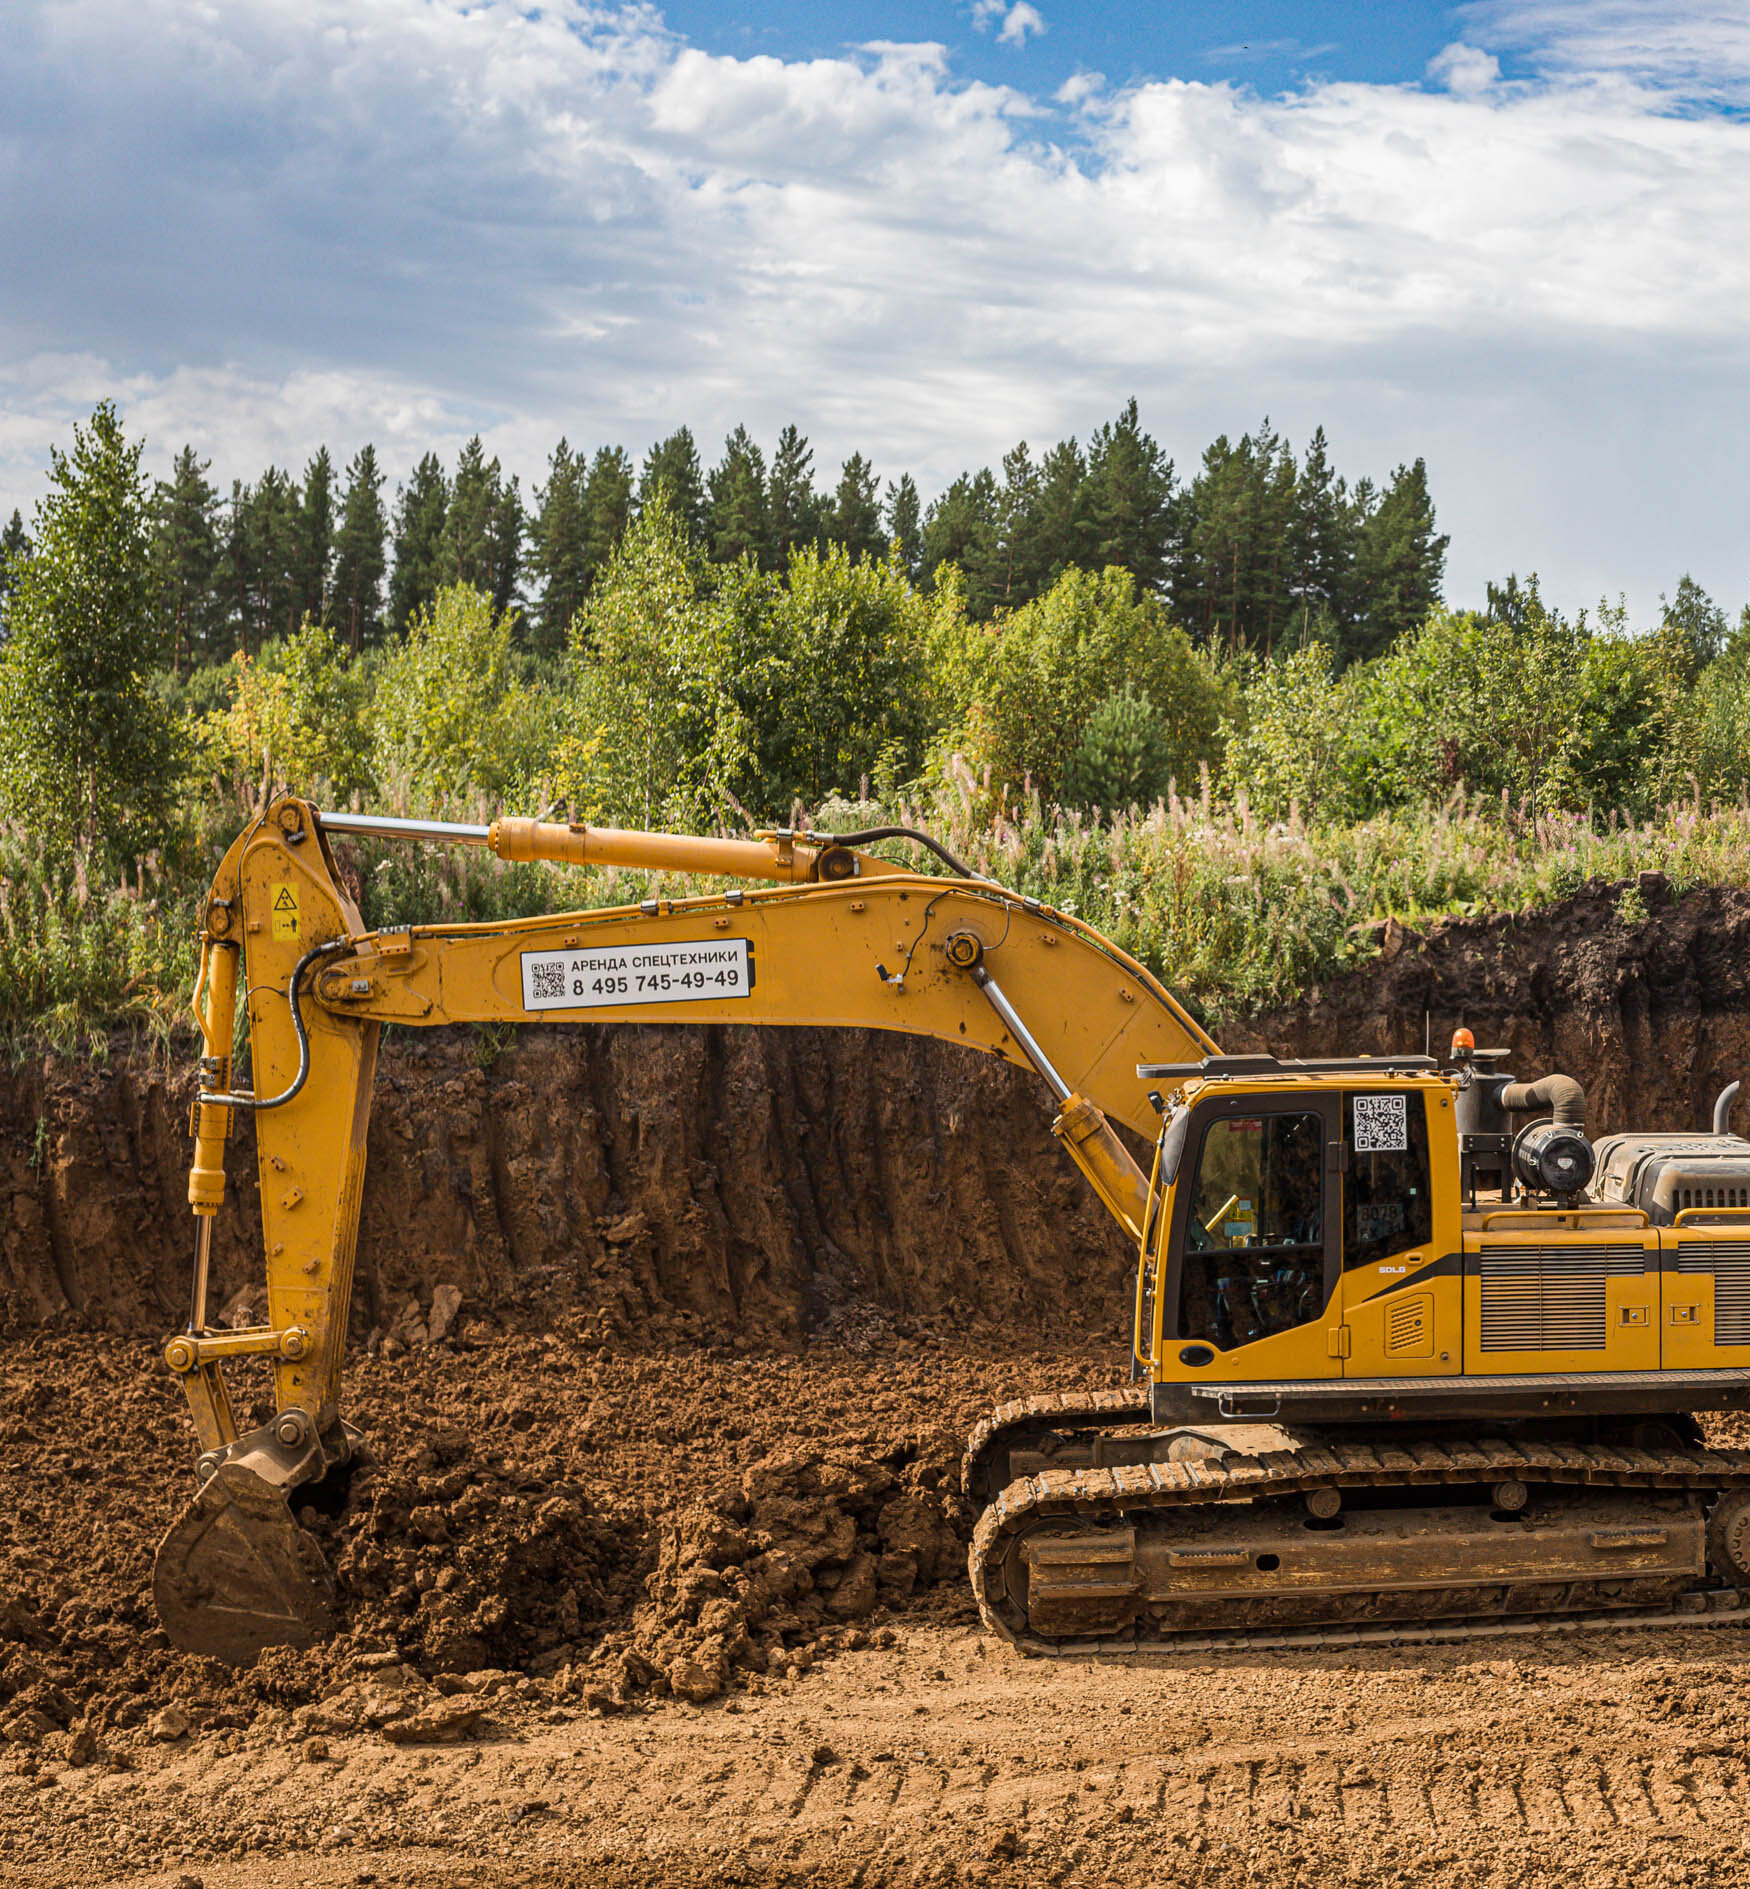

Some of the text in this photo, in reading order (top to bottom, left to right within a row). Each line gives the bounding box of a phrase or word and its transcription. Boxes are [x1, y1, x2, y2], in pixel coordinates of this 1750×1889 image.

[571, 950, 738, 972] АРЕНДА СПЕЦТЕХНИКИ
[573, 969, 739, 996] 8 495 745-49-49
